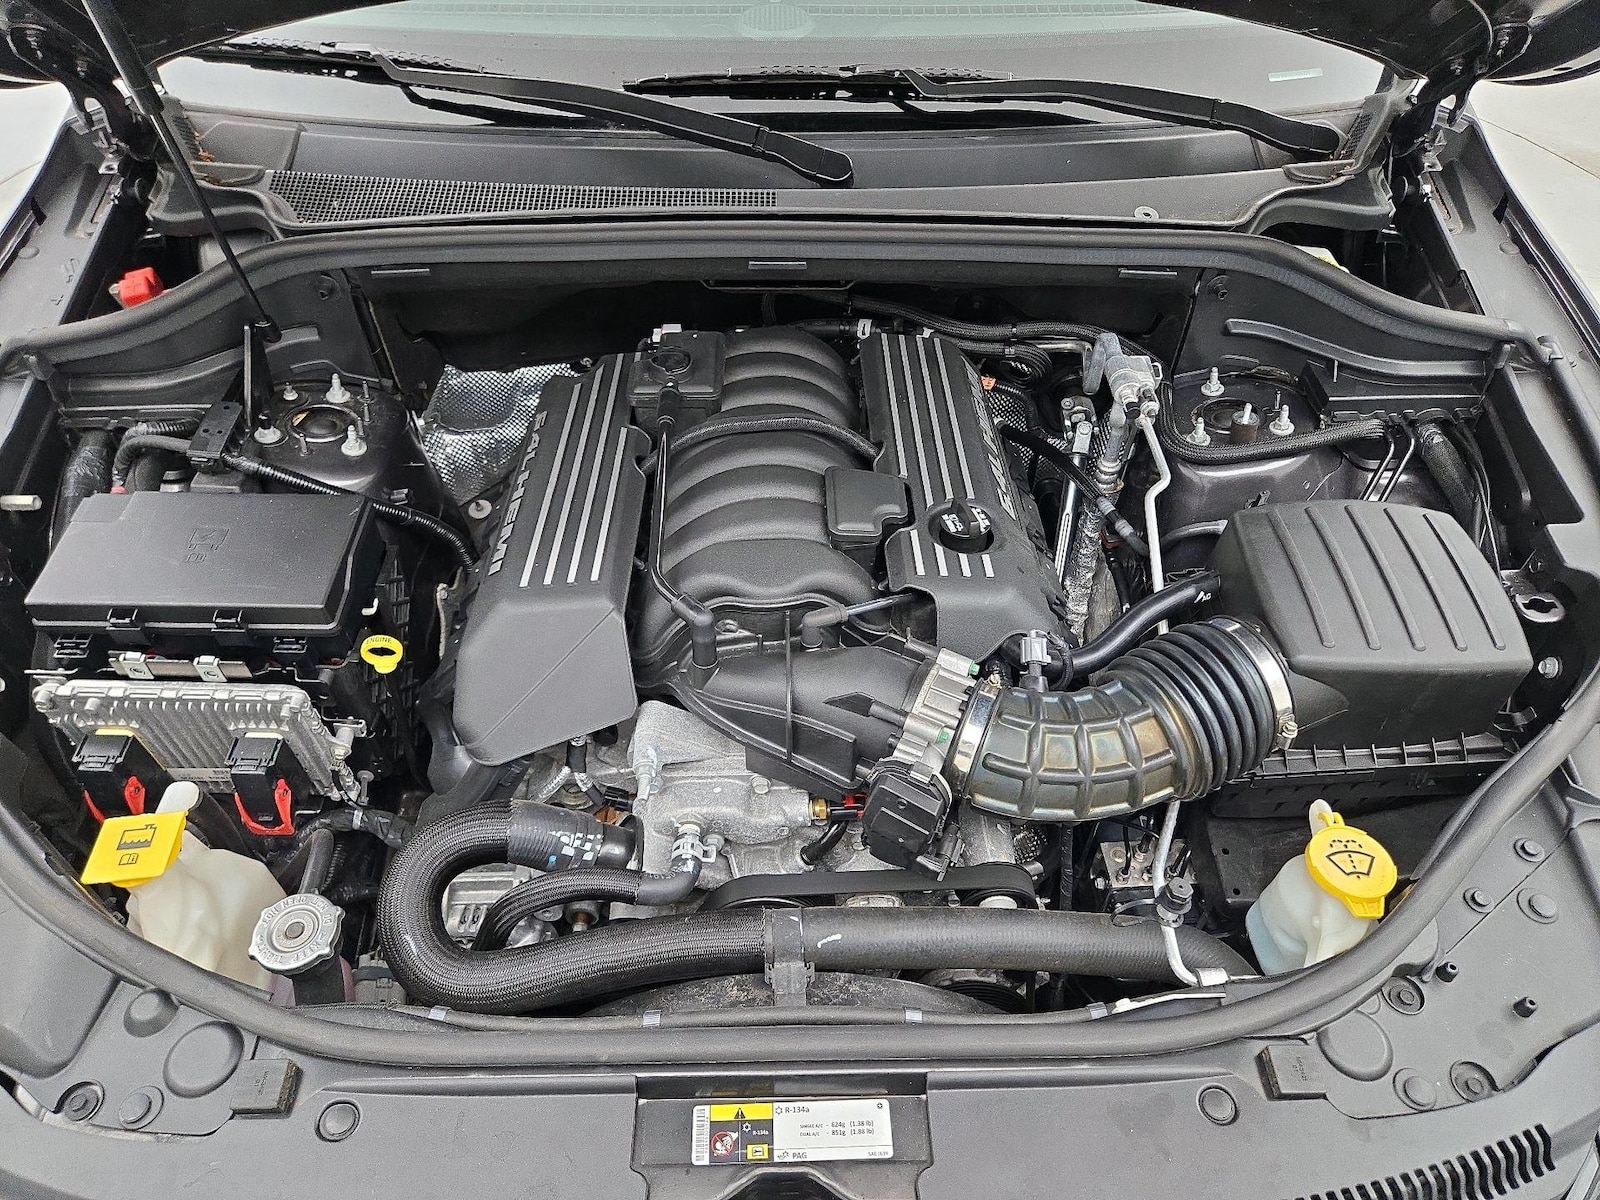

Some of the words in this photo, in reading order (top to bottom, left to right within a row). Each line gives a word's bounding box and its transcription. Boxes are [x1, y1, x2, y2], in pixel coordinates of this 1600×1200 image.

[487, 469, 531, 576] HEMI
[366, 636, 392, 645] ENGINE
[281, 895, 308, 909] OPEN
[309, 897, 329, 912] NOT
[784, 1106, 810, 1114] R-134a
[831, 1121, 846, 1129] 624g
[831, 1129, 847, 1137] 851g
[792, 1151, 808, 1160] PAG
